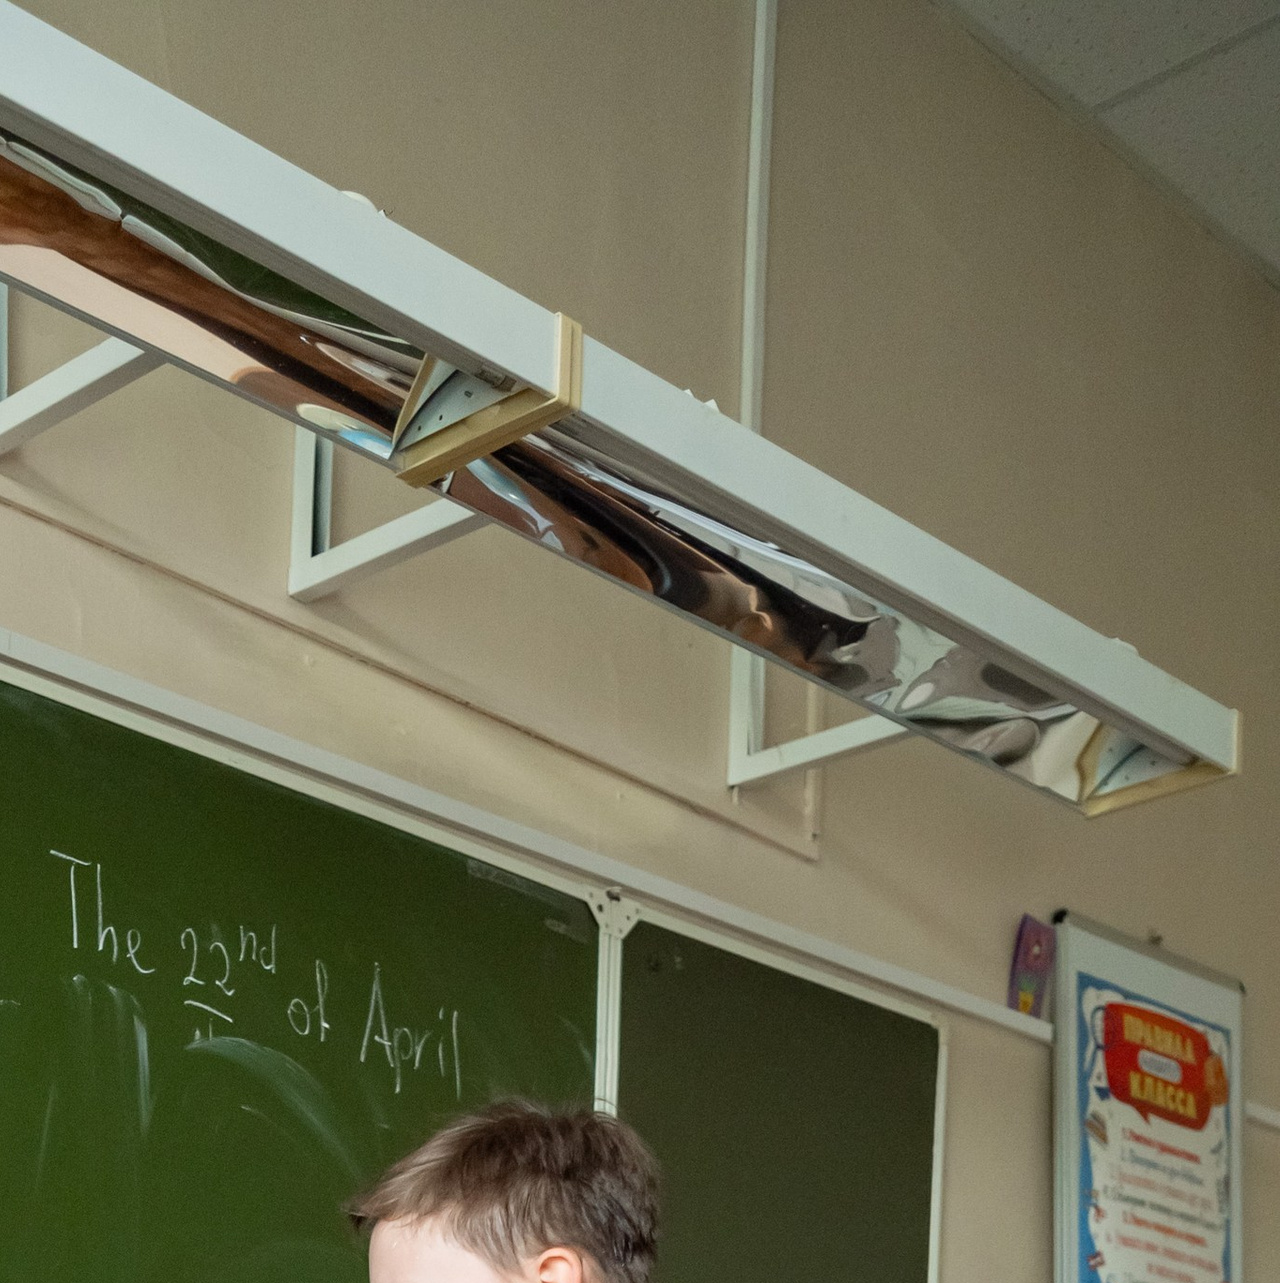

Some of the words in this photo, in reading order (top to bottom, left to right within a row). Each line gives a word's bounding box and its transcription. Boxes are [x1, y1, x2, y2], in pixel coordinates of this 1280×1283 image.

[49, 849, 155, 973] The
[287, 959, 331, 1042] of
[359, 961, 462, 1099] April
